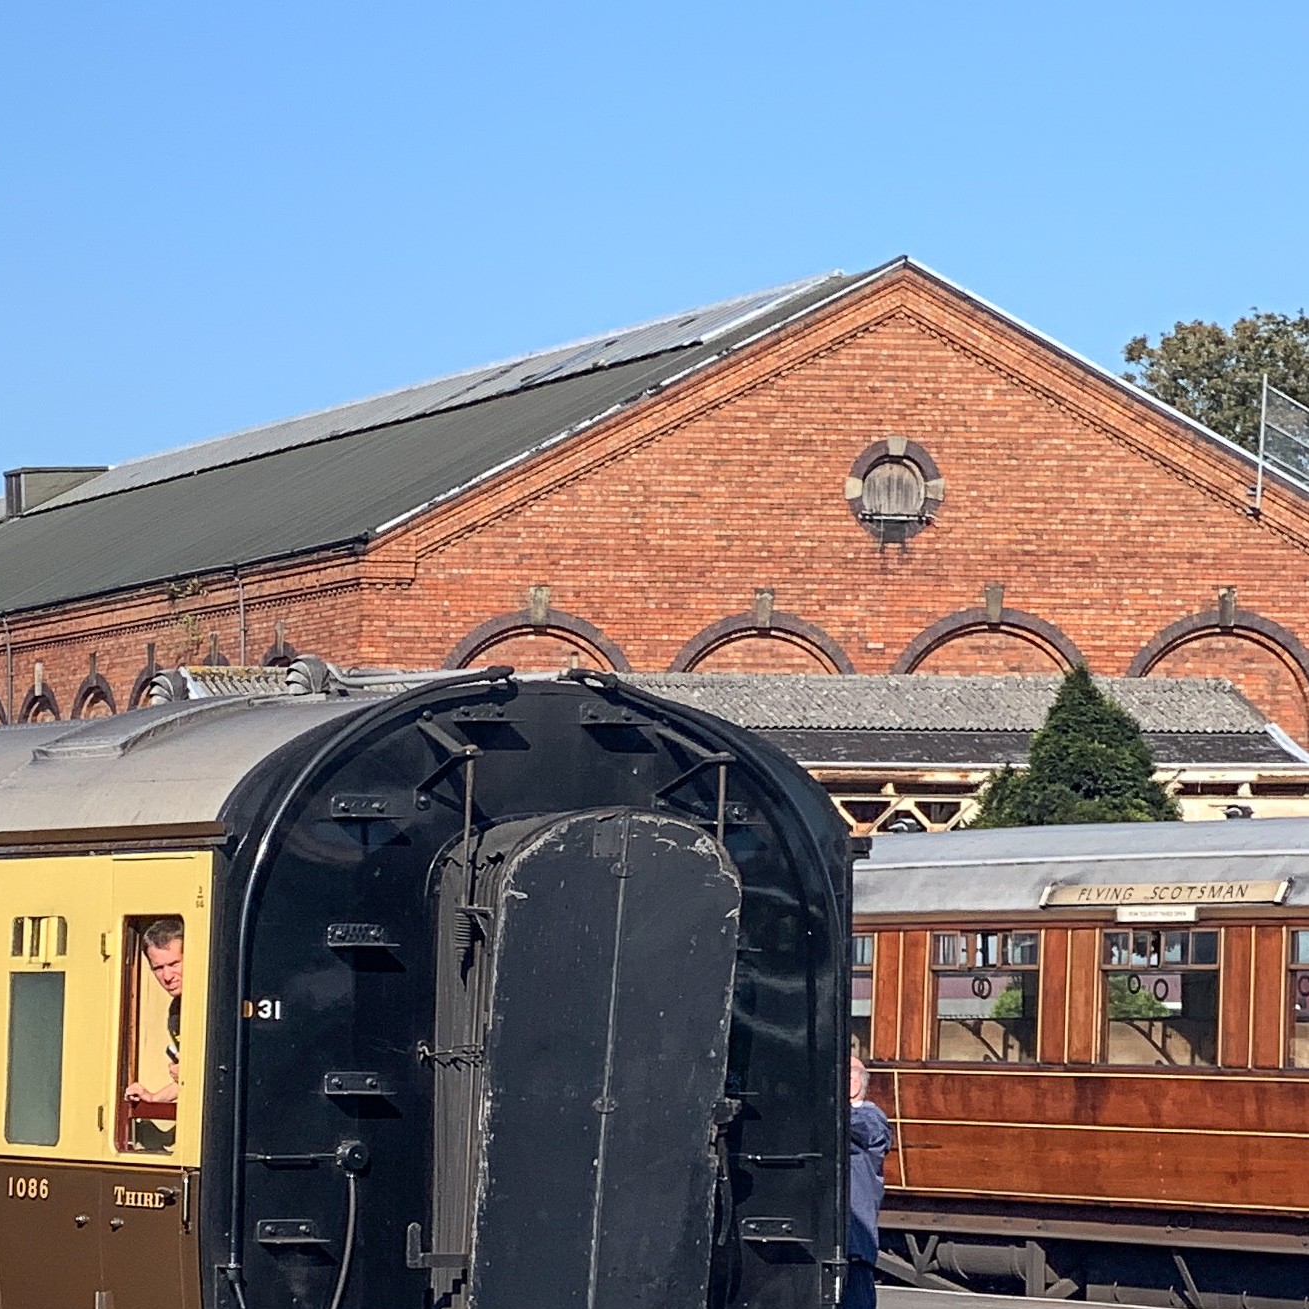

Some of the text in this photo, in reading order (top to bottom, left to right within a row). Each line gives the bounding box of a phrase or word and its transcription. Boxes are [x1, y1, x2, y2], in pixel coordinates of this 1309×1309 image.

[1078, 884, 1249, 901] FLYING SCOTSMAN
[8, 1176, 49, 1199] 1086
